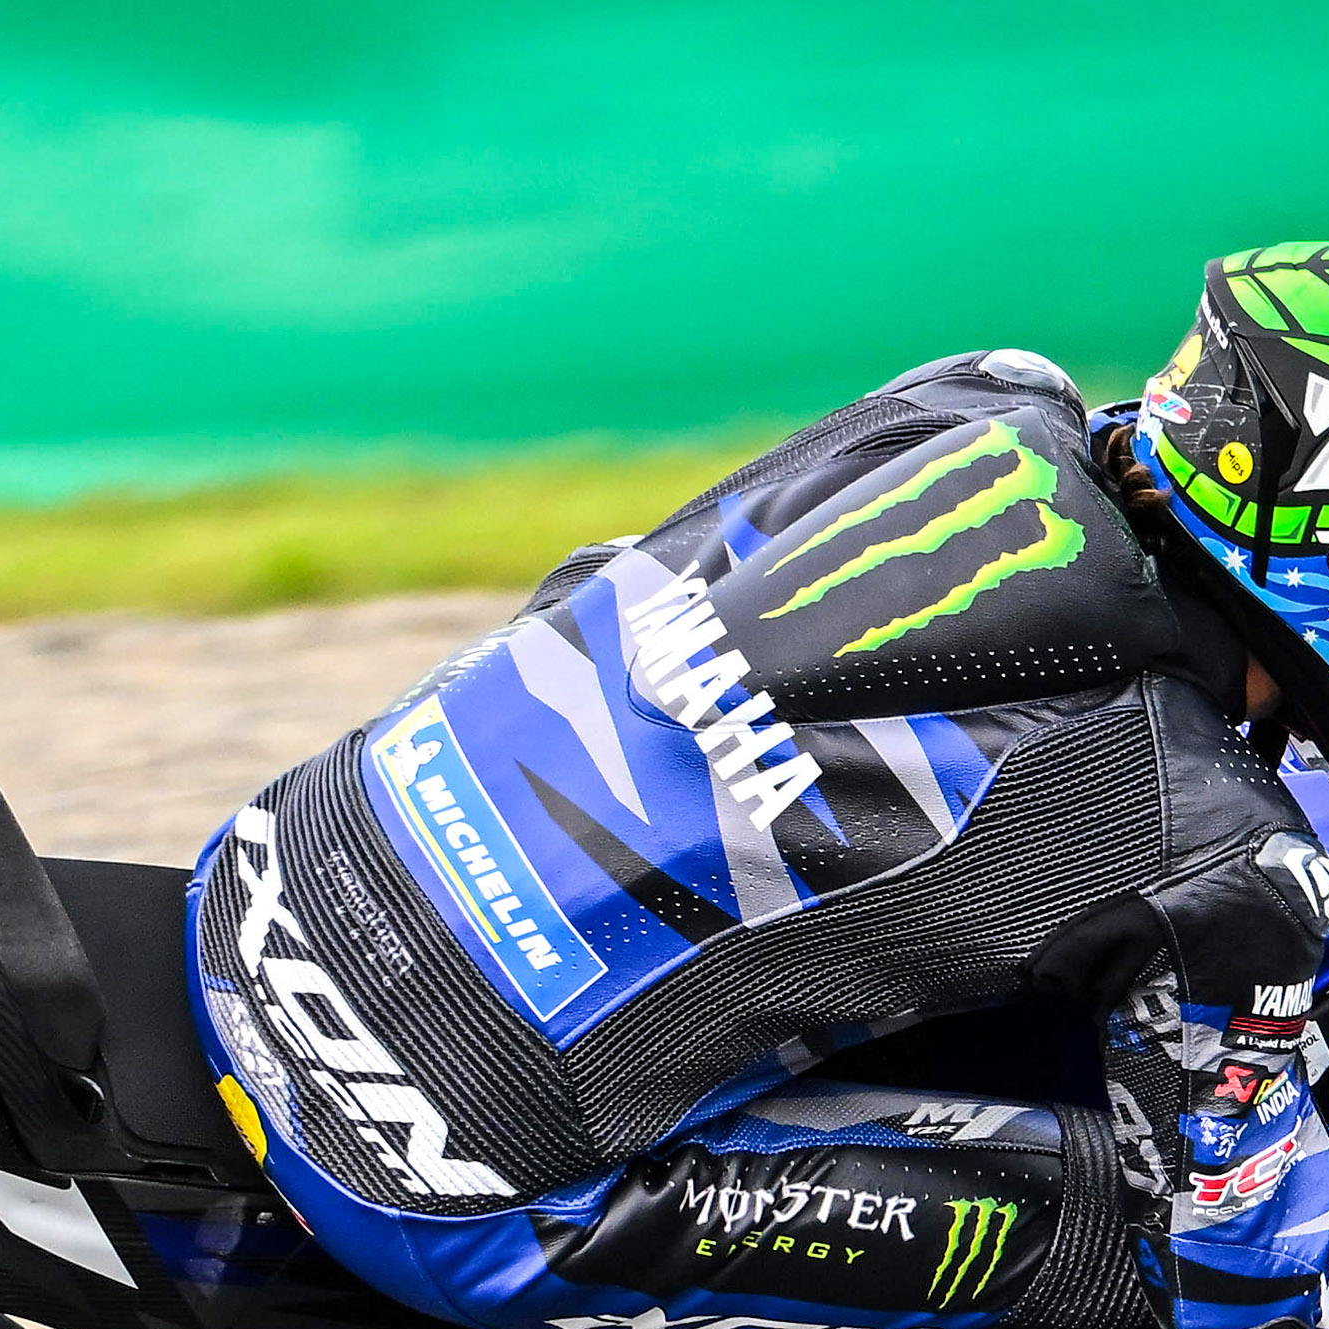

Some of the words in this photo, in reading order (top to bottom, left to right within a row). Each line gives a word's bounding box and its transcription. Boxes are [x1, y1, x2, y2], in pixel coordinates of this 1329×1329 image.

[1225, 450, 1245, 478] Mips
[624, 560, 823, 832] YAMAHA
[414, 774, 563, 972] MICHELIN
[903, 1102, 1036, 1142] M1
[1256, 1080, 1301, 1125] INDIA
[906, 1125, 958, 1136] YZR
[695, 1231, 865, 1264] EERGY
